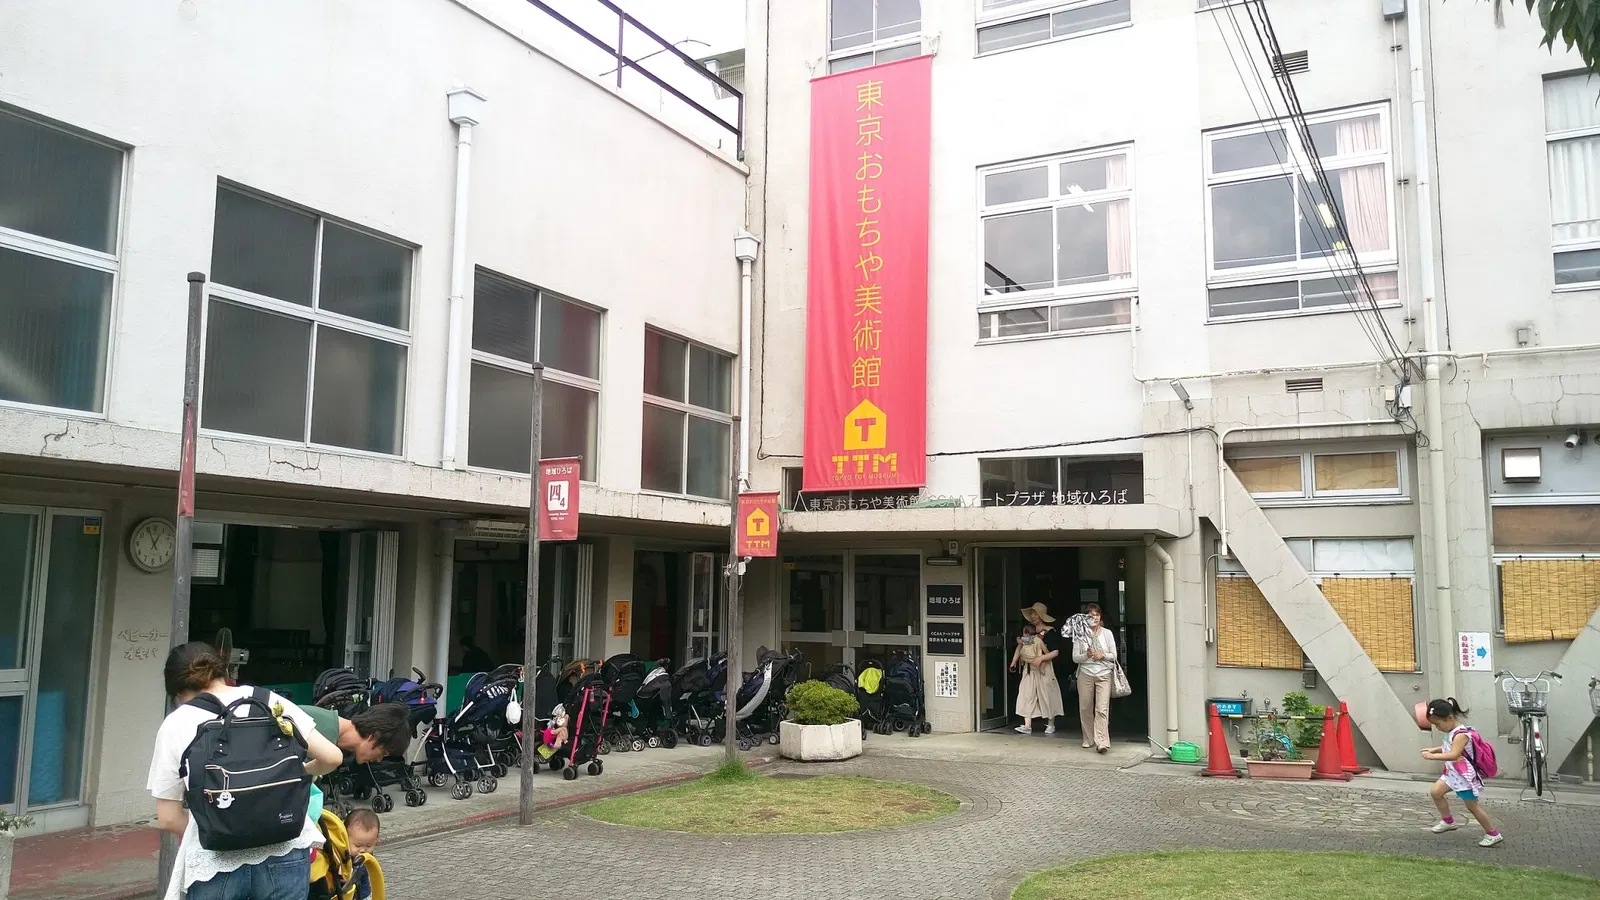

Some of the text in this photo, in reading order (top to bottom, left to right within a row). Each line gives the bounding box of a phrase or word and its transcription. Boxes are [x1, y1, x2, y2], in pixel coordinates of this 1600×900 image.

[855, 417, 877, 442] T
[545, 466, 573, 475] 地域ひろば
[831, 452, 898, 474] TTM
[550, 484, 562, 501] 四
[1051, 488, 1128, 505] 地域ひろば
[560, 498, 566, 508] 4
[746, 540, 770, 549] TTM
